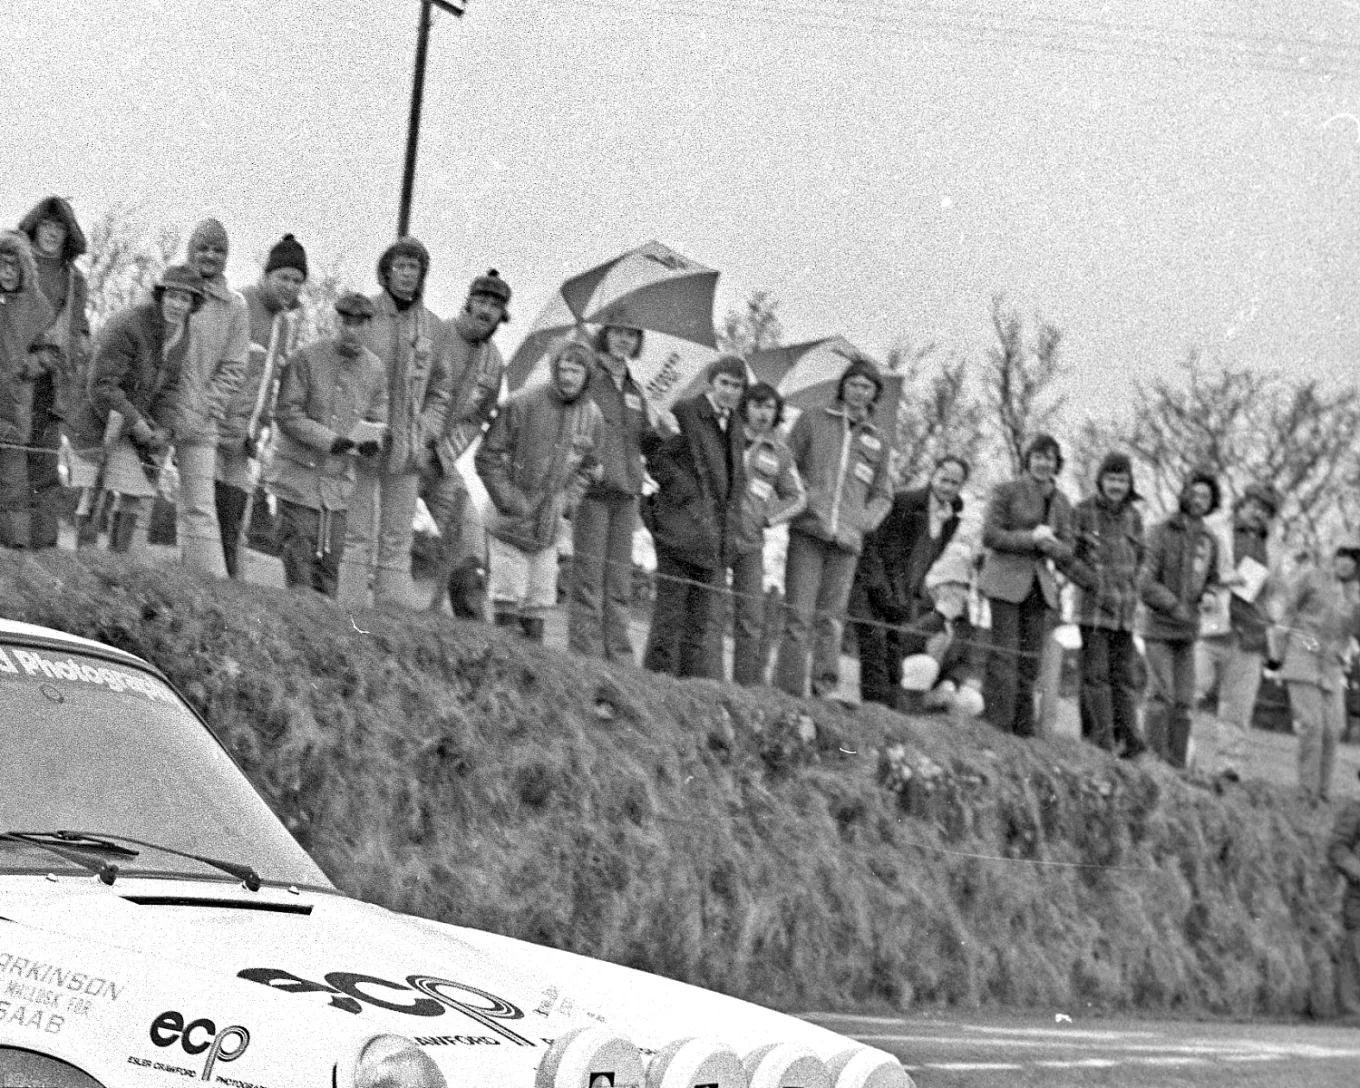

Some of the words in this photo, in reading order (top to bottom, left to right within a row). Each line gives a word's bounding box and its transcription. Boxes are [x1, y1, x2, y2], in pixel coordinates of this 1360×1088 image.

[150, 1010, 250, 1081] ecp
[413, 1035, 501, 1046] AWFORD
[127, 1056, 152, 1068] ESLER
